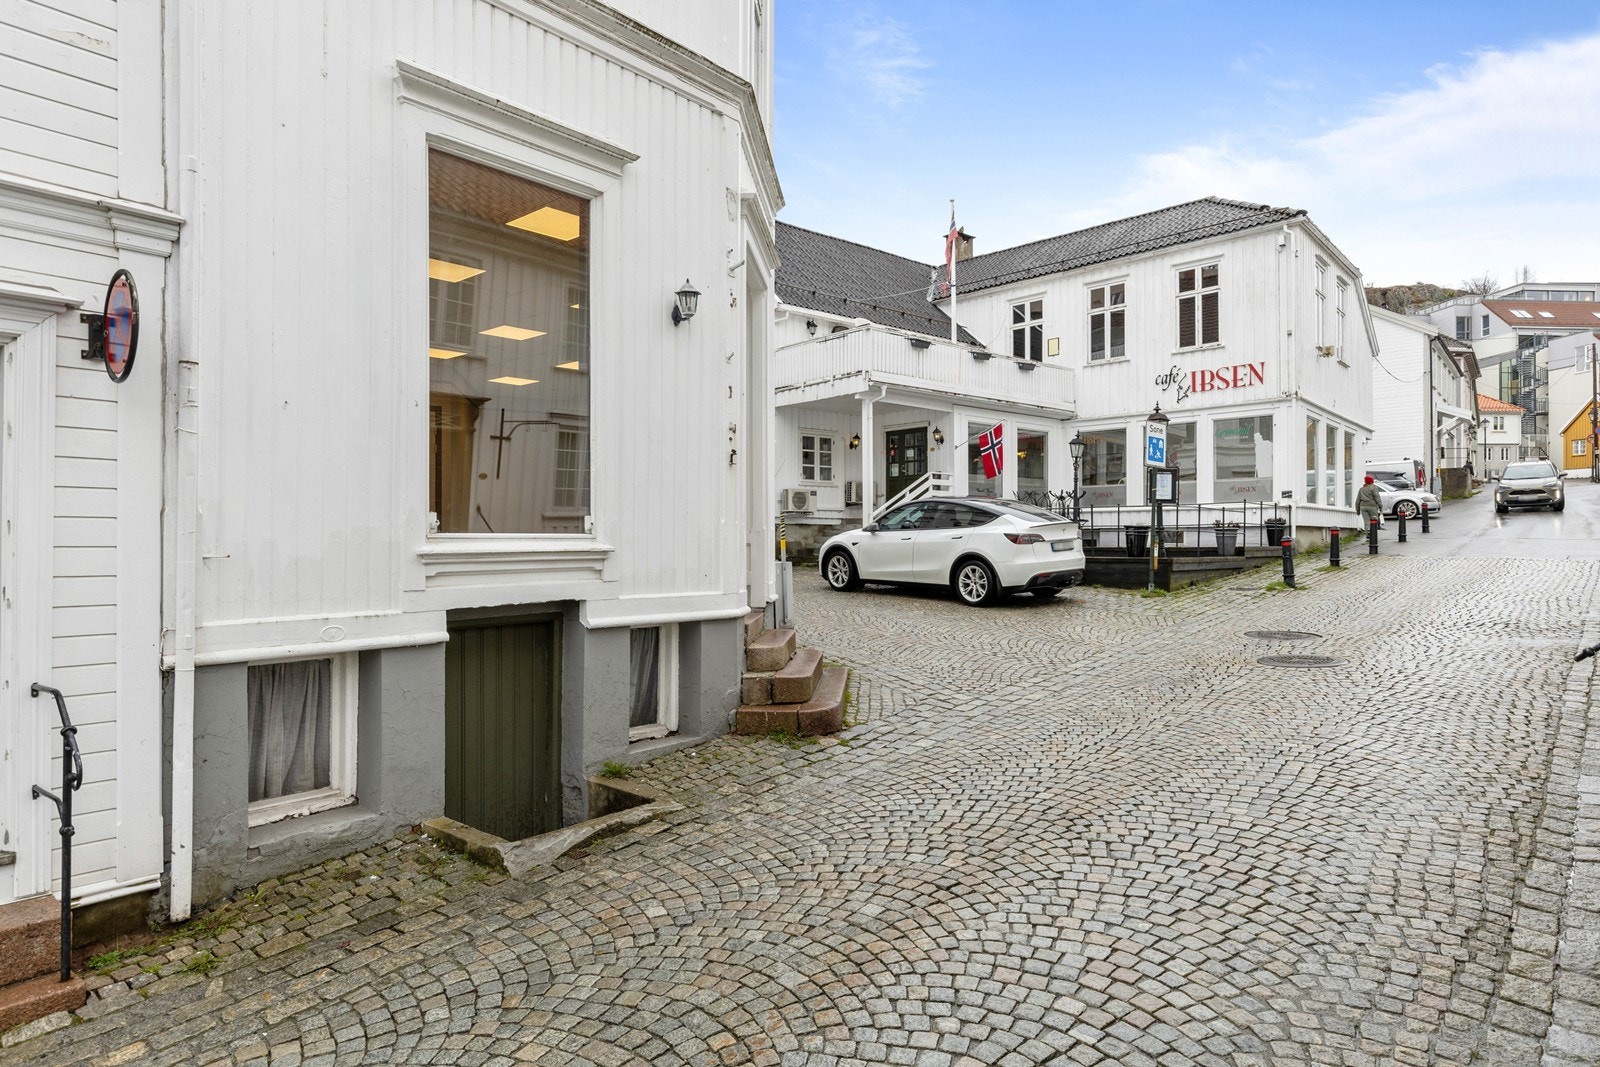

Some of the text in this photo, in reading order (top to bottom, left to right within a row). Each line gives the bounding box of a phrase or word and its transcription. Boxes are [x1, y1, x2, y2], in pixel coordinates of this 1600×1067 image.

[1155, 361, 1265, 394] café IBSEN
[1149, 424, 1164, 435] Sone
